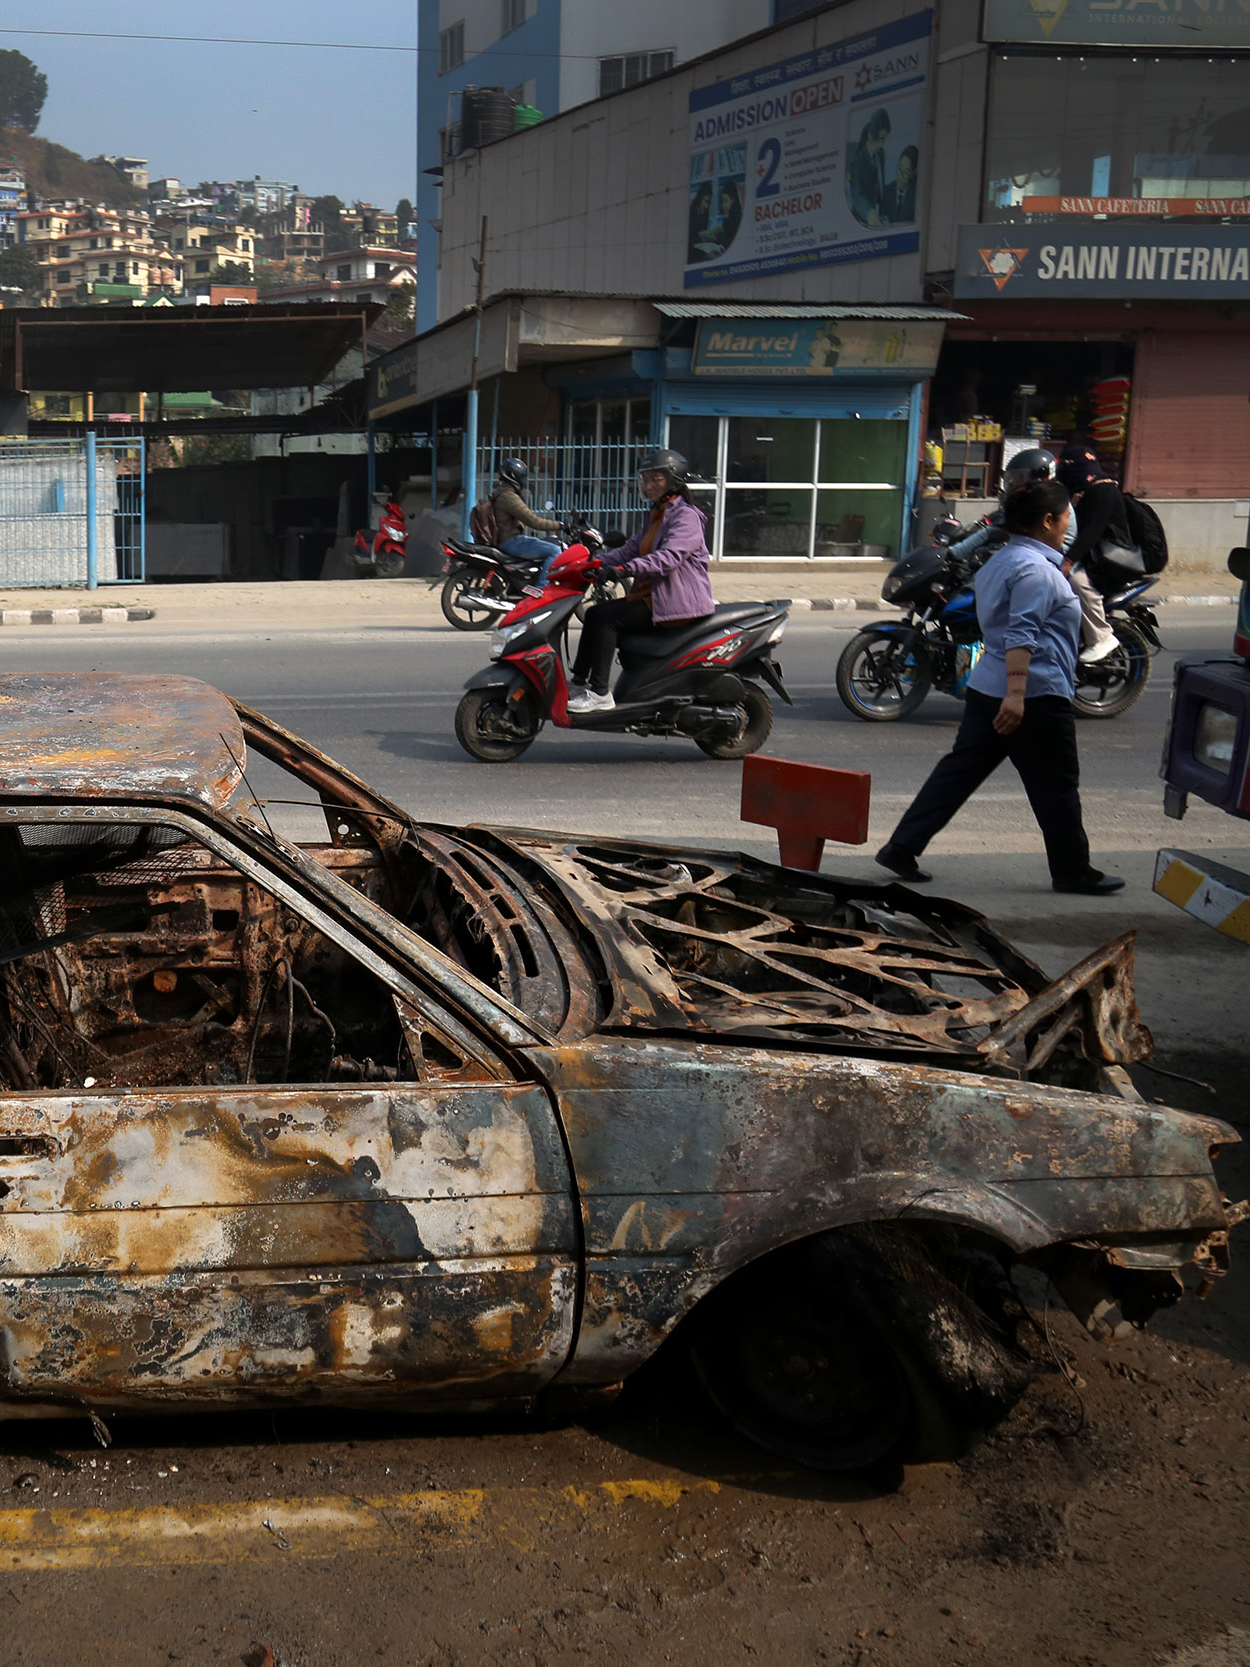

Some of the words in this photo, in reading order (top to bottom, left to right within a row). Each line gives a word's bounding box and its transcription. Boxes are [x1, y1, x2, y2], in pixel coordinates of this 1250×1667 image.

[1088, 13, 1189, 24] INTERNATIONAL
[874, 52, 920, 78] SANN
[694, 96, 787, 143] ADMISSION
[792, 77, 843, 113] OPEN
[755, 192, 823, 222] BACHELOR
[1060, 198, 1093, 213] SANN
[1097, 198, 1170, 214] CAFETERIA
[1195, 199, 1229, 214] SANN
[1037, 244, 1119, 281] SANN
[1125, 246, 1249, 281] INTERNA
[707, 331, 800, 352] Marvel
